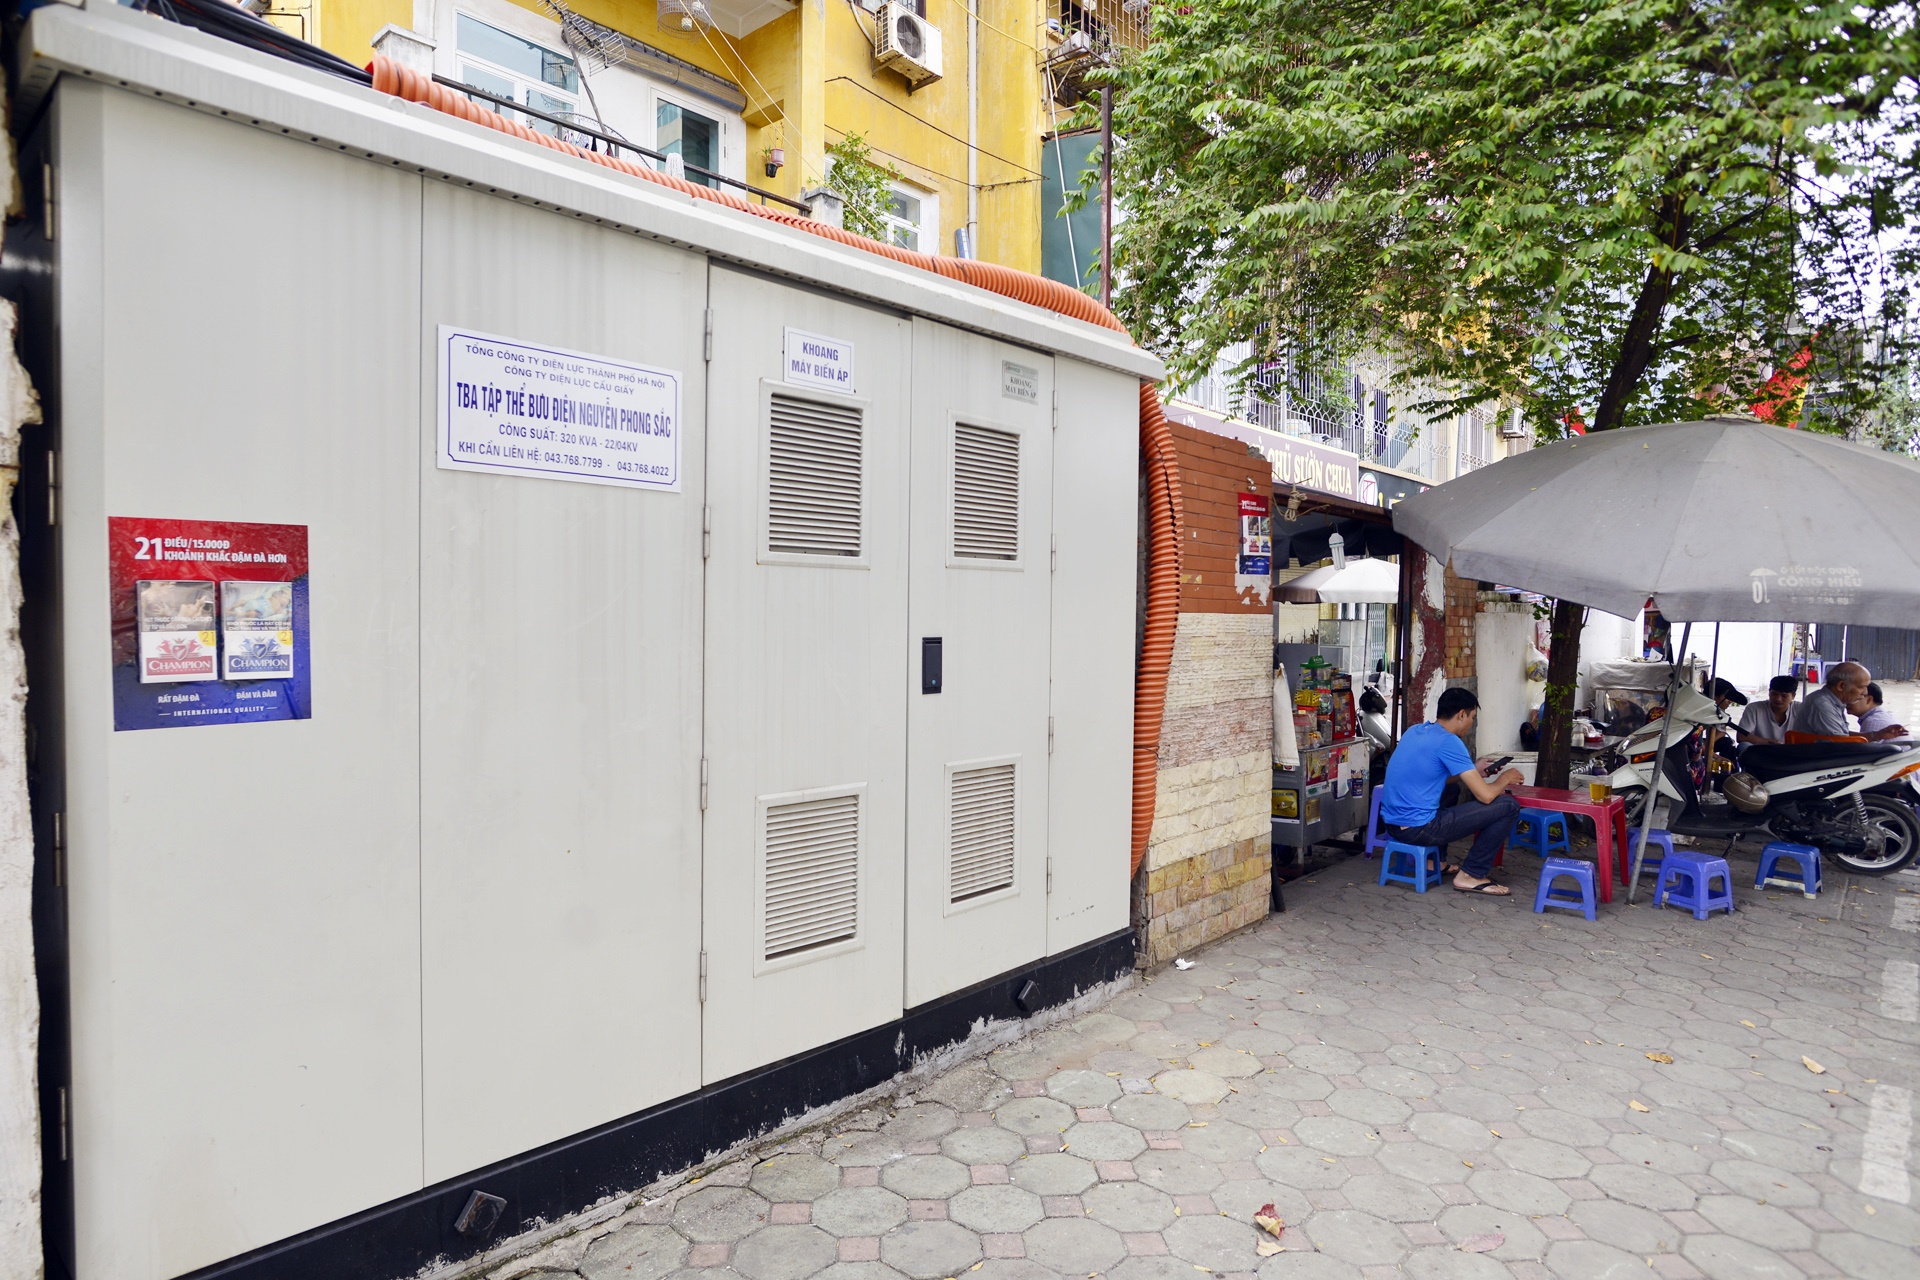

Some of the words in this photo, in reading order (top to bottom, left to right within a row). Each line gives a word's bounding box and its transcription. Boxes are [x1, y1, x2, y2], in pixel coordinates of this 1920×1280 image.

[803, 342, 838, 361] KHOANG
[466, 342, 494, 357] TỔNG
[497, 350, 525, 363] CÔNG
[528, 356, 539, 365] TY
[542, 359, 564, 370] ĐIỆN
[567, 363, 584, 374] LỰC
[587, 367, 616, 379] THÀNH
[619, 372, 635, 383] PHỐ
[638, 376, 649, 385] HÀ
[651, 379, 665, 390] NỘI
[791, 359, 811, 374] MÁY
[814, 363, 834, 380] BIẾN
[837, 367, 848, 382] ÁP
[504, 365, 532, 377] CÔNG
[535, 371, 546, 379] TY
[550, 373, 571, 385] ĐIỆN
[574, 377, 591, 388] LỰC
[614, 384, 634, 395] GIẤY
[457, 382, 478, 409] TBA
[482, 381, 502, 418] TẬP
[506, 382, 525, 416] THỂ
[528, 393, 549, 420] BƯU
[553, 394, 576, 428] ĐIỆN
[579, 397, 617, 430] NGUYỄN
[620, 408, 651, 435] PHONG
[654, 408, 671, 438] SẮC
[499, 422, 527, 438] CÔNG
[529, 426, 558, 441] SUẤT:
[560, 433, 576, 444] 320
[579, 435, 597, 447] KVA
[604, 439, 638, 452] 22/04KV
[458, 441, 476, 453] KHI
[478, 440, 500, 456] CẦN
[503, 444, 524, 459] LIÊN
[527, 447, 542, 464] HỆ:
[544, 452, 603, 468] 043.768.7799
[617, 461, 669, 476] 043.768.4022
[1325, 462, 1353, 495] CHUA
[134, 537, 163, 560] 21
[231, 551, 252, 564] ĐẬM
[253, 551, 266, 563] ĐÀ
[268, 553, 287, 563] HƠN
[202, 631, 215, 643] 21
[148, 660, 211, 671] CHAMPION
[231, 658, 288, 668] CHAMPION
[189, 692, 200, 702] ĐÀ
[252, 690, 261, 699] VÀ
[173, 707, 232, 717] INTERNATIONAL
[234, 706, 265, 714] QUALITY
